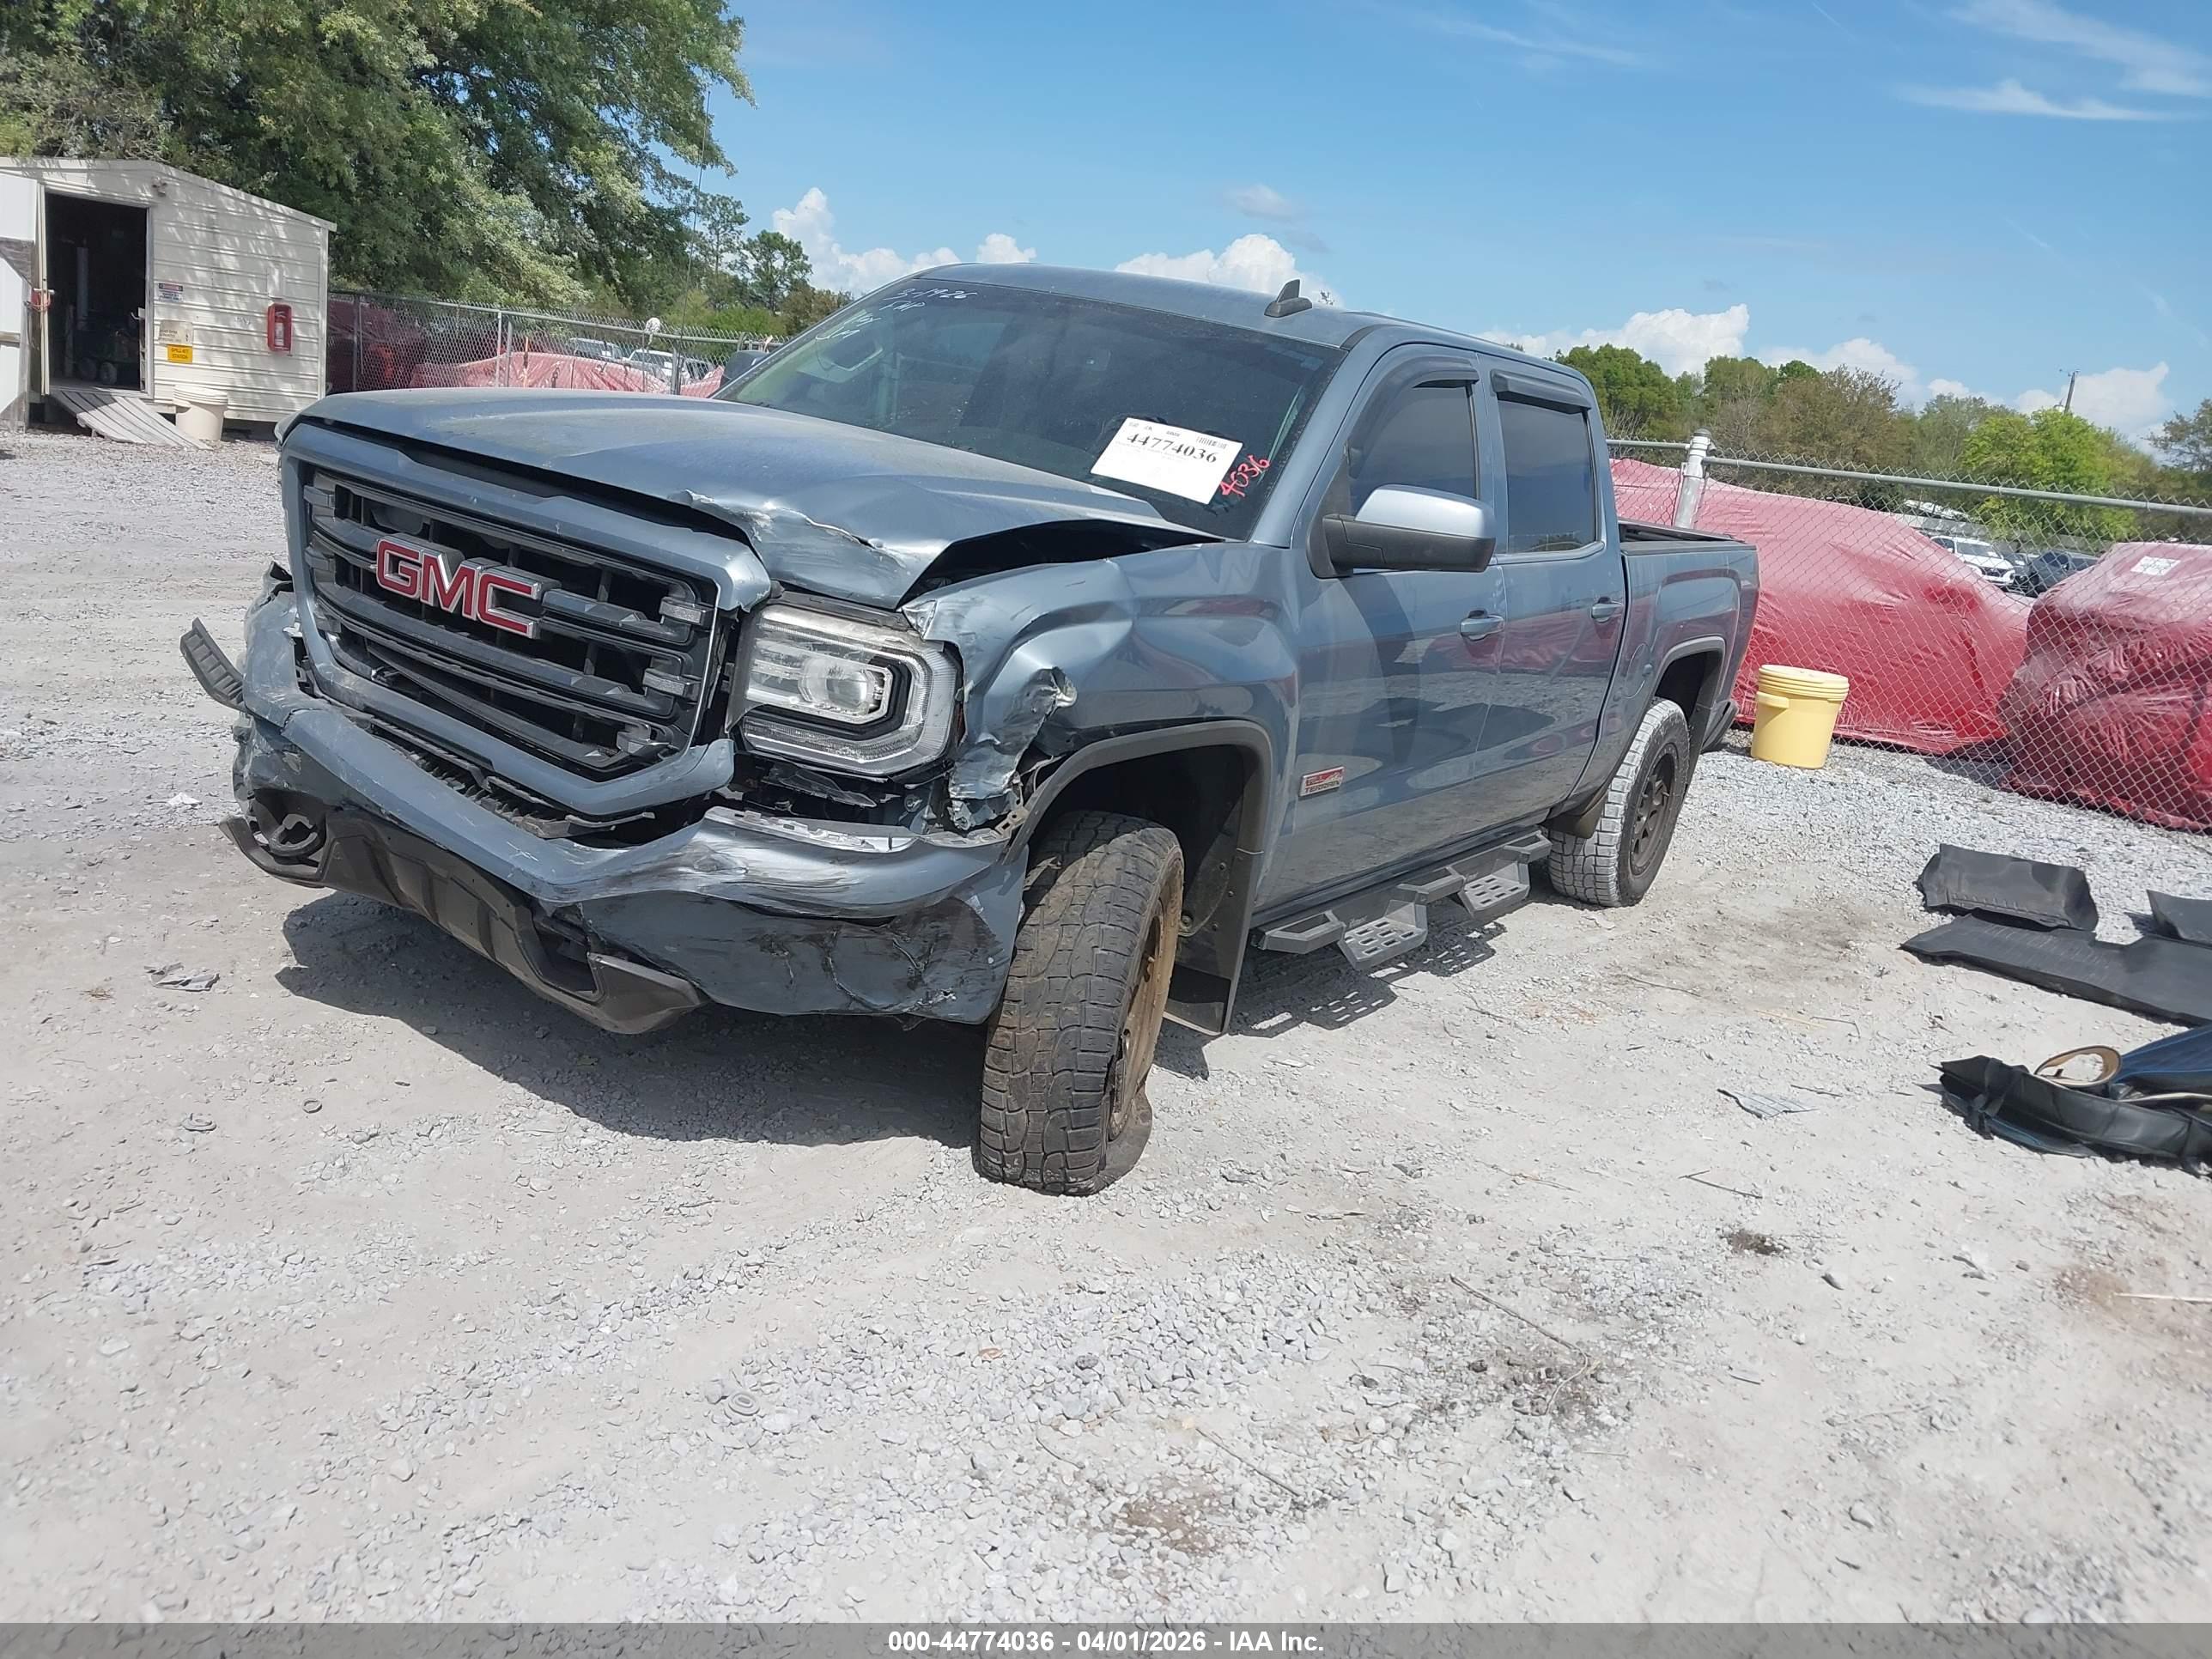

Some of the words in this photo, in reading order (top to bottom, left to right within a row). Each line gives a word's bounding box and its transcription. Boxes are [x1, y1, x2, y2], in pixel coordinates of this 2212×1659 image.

[1127, 433, 1219, 464] 44774036
[1220, 455, 1270, 498] 4036
[376, 535, 541, 639] GMC
